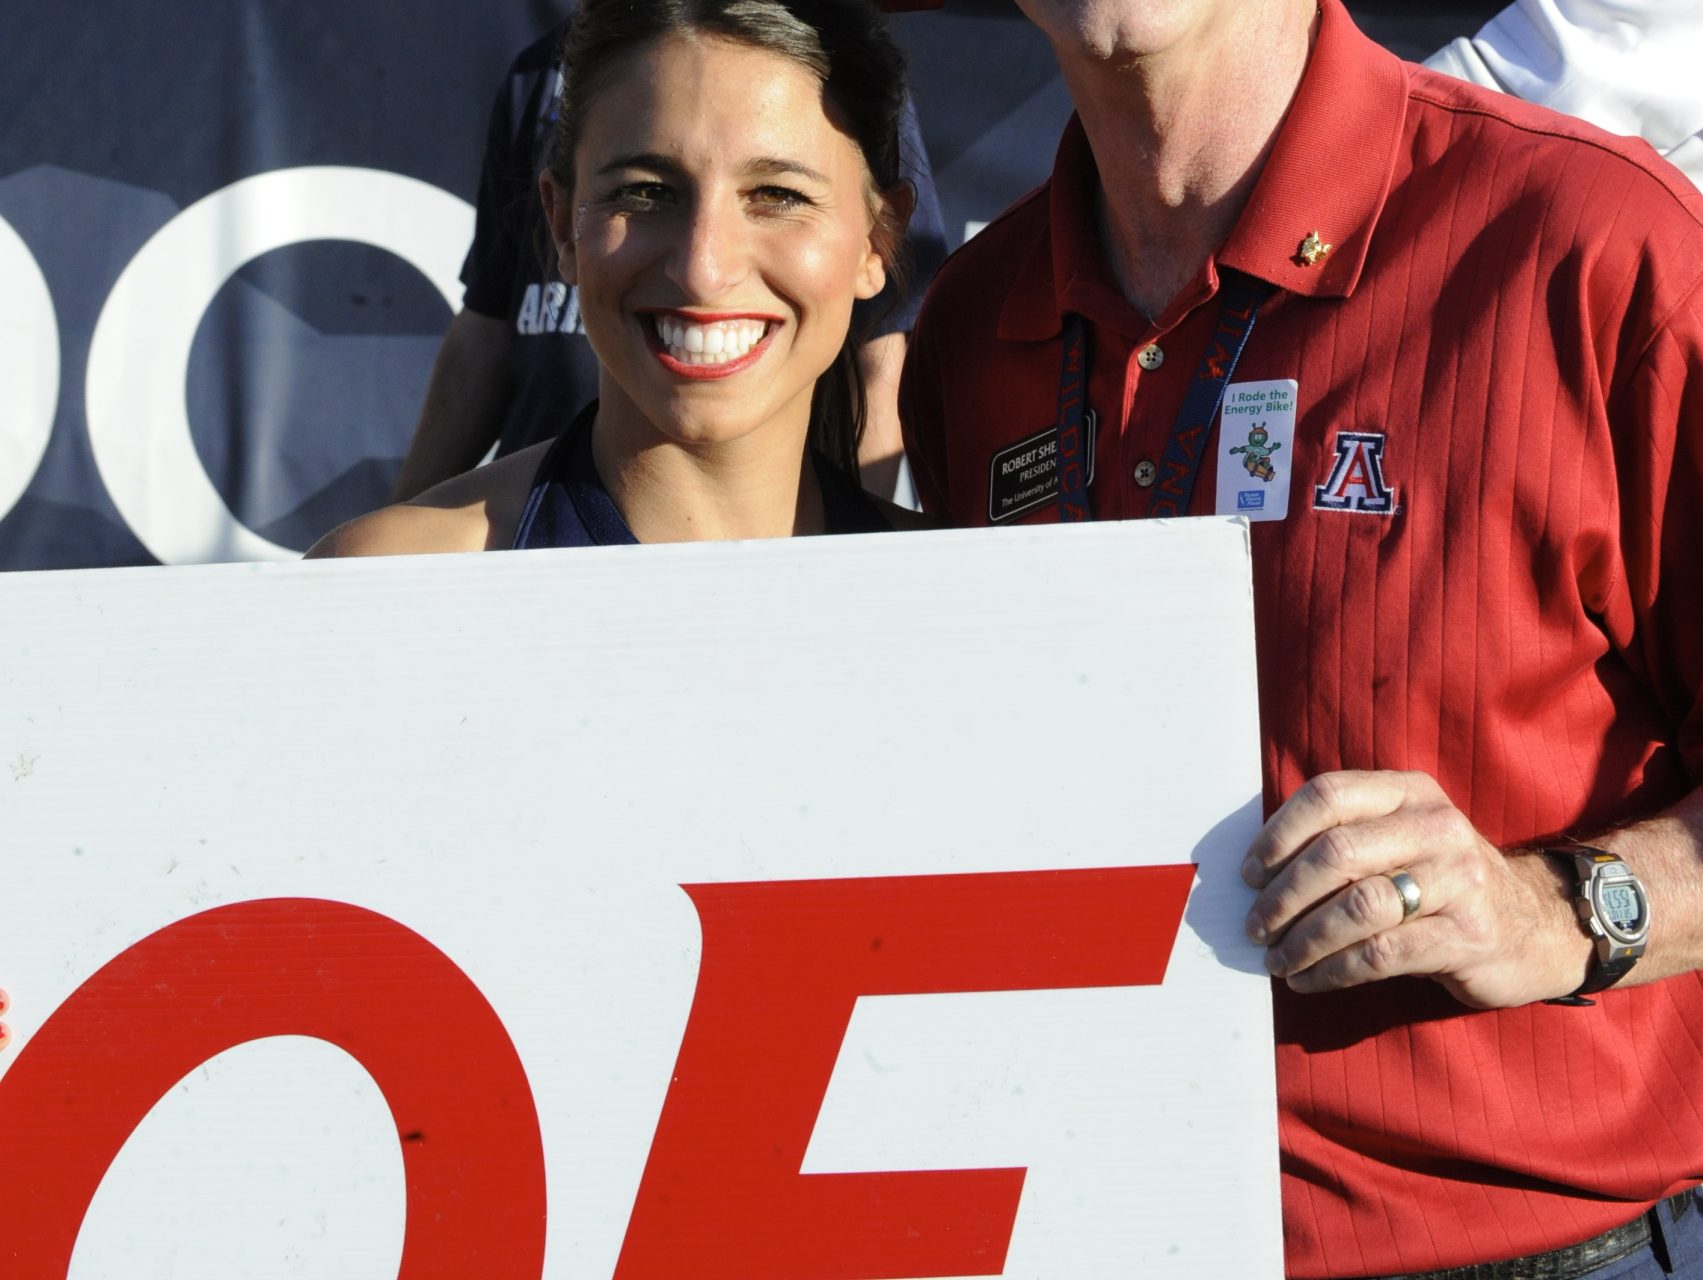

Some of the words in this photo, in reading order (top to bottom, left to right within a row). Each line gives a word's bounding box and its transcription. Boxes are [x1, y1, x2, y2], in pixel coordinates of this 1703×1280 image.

[517, 282, 587, 334] ARI
[1224, 403, 1263, 416] Energy
[1265, 401, 1294, 413] Bike!
[1231, 392, 1236, 403] I
[1238, 390, 1267, 402] Rode
[1269, 389, 1289, 401] the
[1002, 449, 1037, 476] ROBERT
[1038, 441, 1057, 460] SHE
[1312, 431, 1395, 515] A
[1002, 497, 1014, 508] The
[1014, 483, 1045, 504] University
[1045, 479, 1053, 490] of
